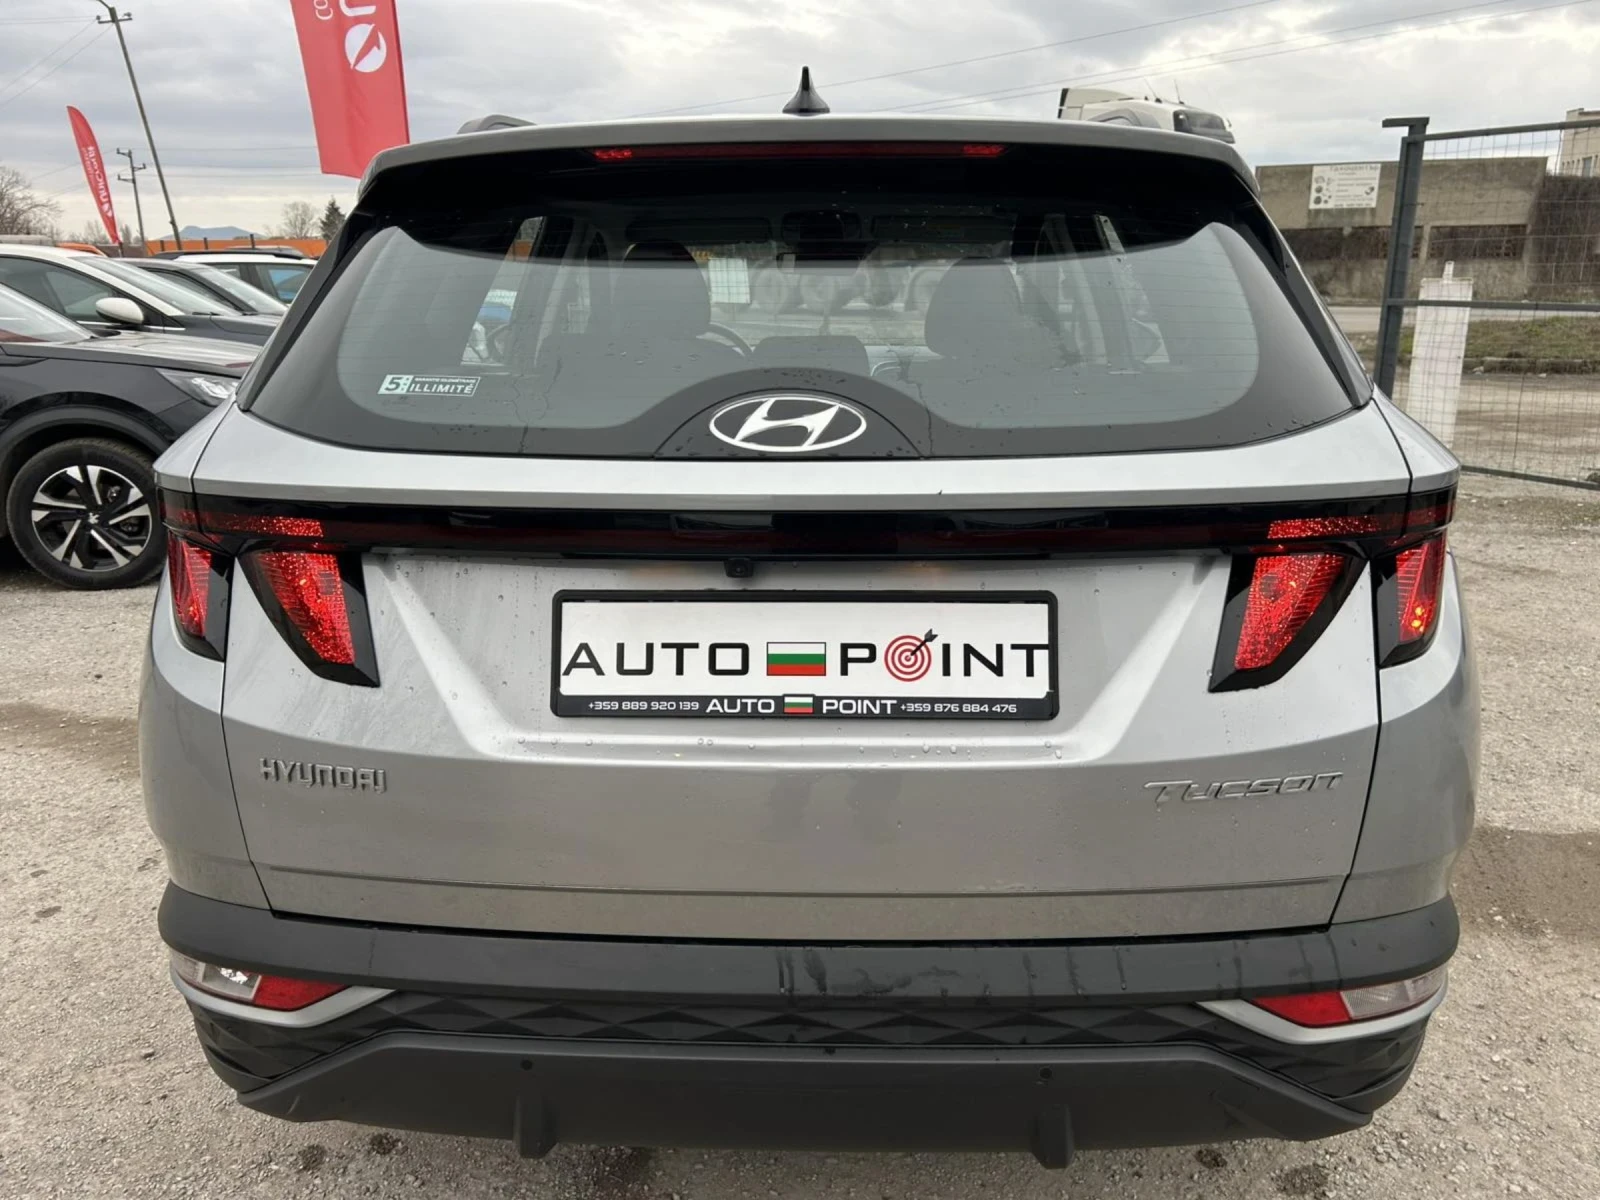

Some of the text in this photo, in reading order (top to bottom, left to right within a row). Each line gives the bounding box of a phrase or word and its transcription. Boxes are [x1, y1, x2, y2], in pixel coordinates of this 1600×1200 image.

[384, 376, 404, 391] 5
[409, 383, 474, 394] ILLIMITÉ
[562, 642, 750, 676] AUTO
[588, 698, 1017, 714] +359 889 920 139 AUTO POINT +359 876 884 476
[259, 757, 388, 794] HYUNDAI
